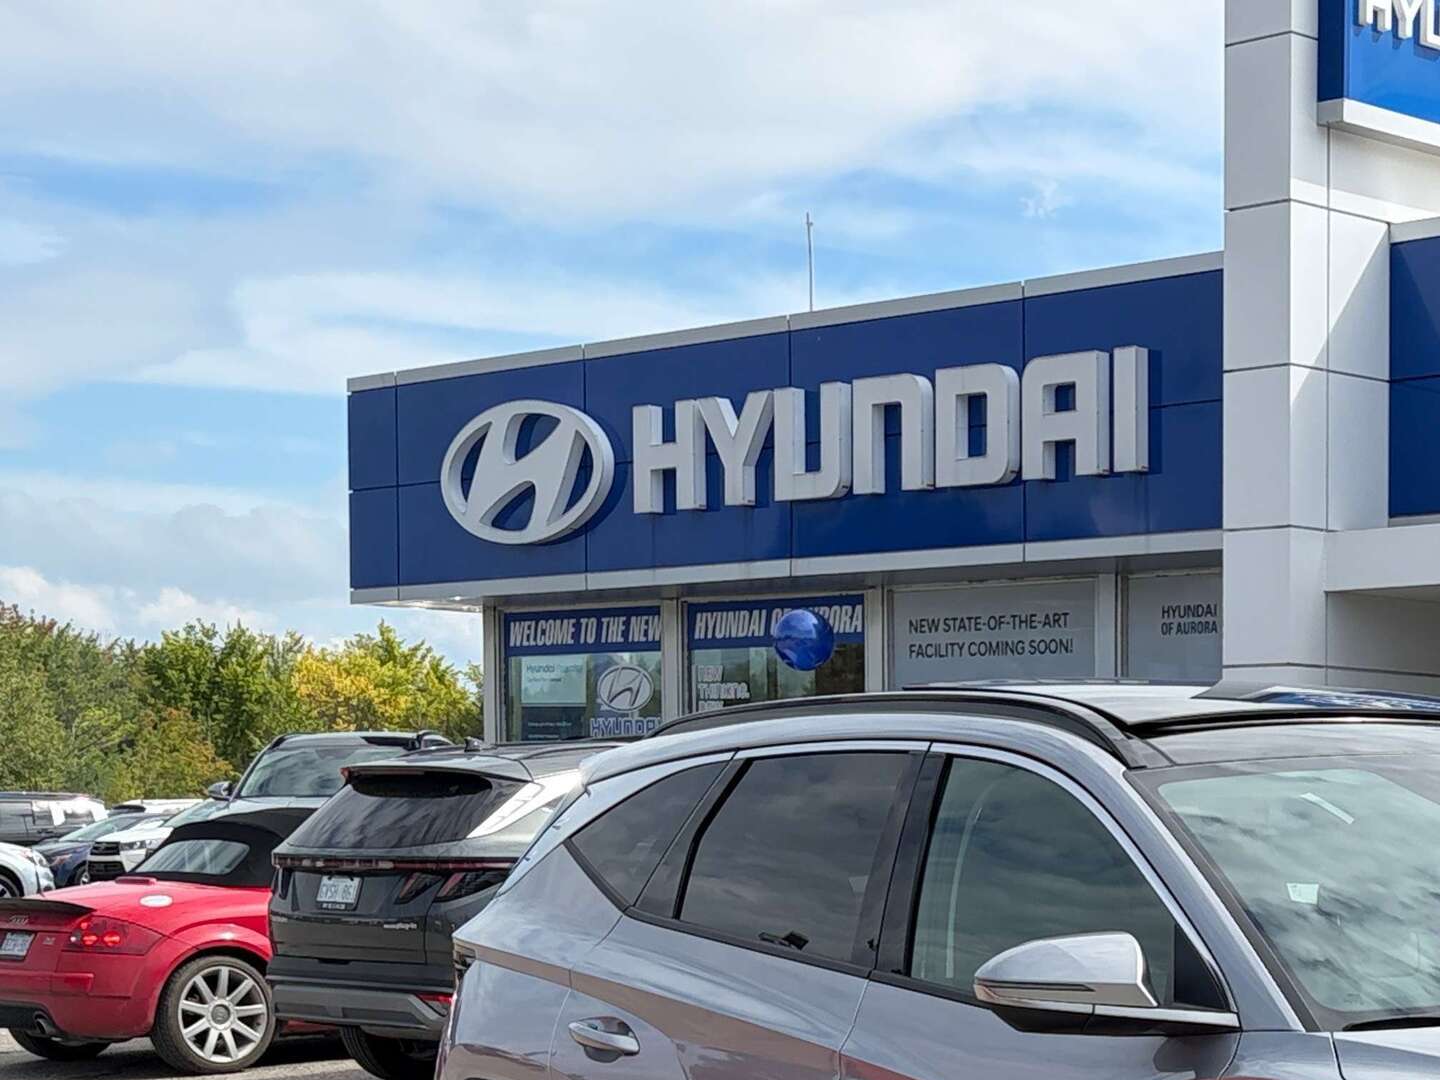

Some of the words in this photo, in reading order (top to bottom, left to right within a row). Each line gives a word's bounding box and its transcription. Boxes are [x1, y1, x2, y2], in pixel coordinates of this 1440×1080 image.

[633, 345, 1150, 515] HYUNDAI
[1161, 603, 1217, 619] HYUNDAI
[509, 618, 577, 648] WELCOME
[579, 617, 602, 644] TO
[600, 615, 626, 644] THE
[628, 614, 662, 642] NEW
[694, 609, 768, 640] HYUNDAI
[908, 617, 942, 635] NEW
[942, 612, 1071, 633] STATE-OF-THE-ART
[1161, 622, 1175, 636] OF
[1175, 620, 1218, 636] AURORA
[908, 641, 966, 660] FACILITY
[967, 639, 1026, 657] COMING
[1027, 637, 1074, 656] SOON!
